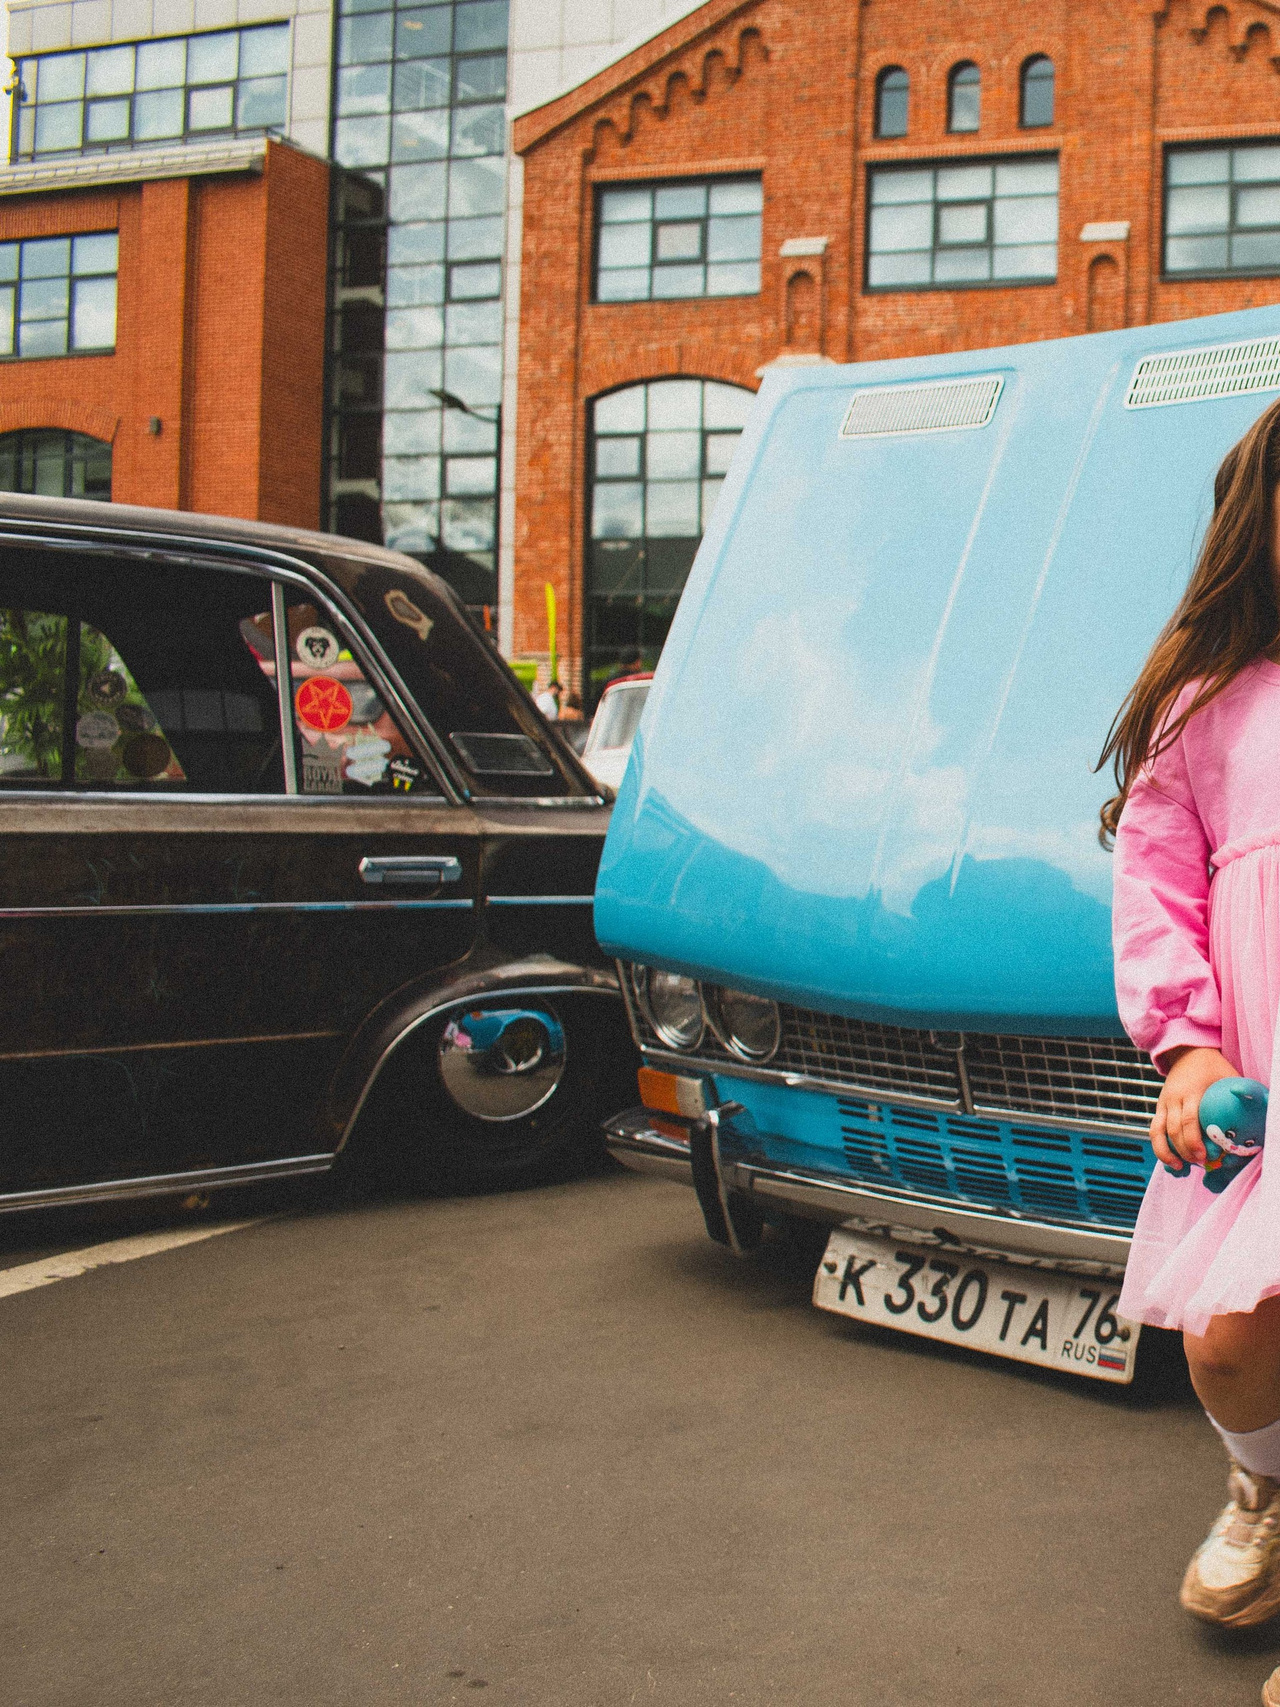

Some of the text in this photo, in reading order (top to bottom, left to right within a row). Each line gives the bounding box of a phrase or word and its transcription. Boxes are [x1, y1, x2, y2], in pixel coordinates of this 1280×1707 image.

[839, 1251, 1121, 1351] К 330 ТА 76
[1061, 1340, 1097, 1364] RUS
